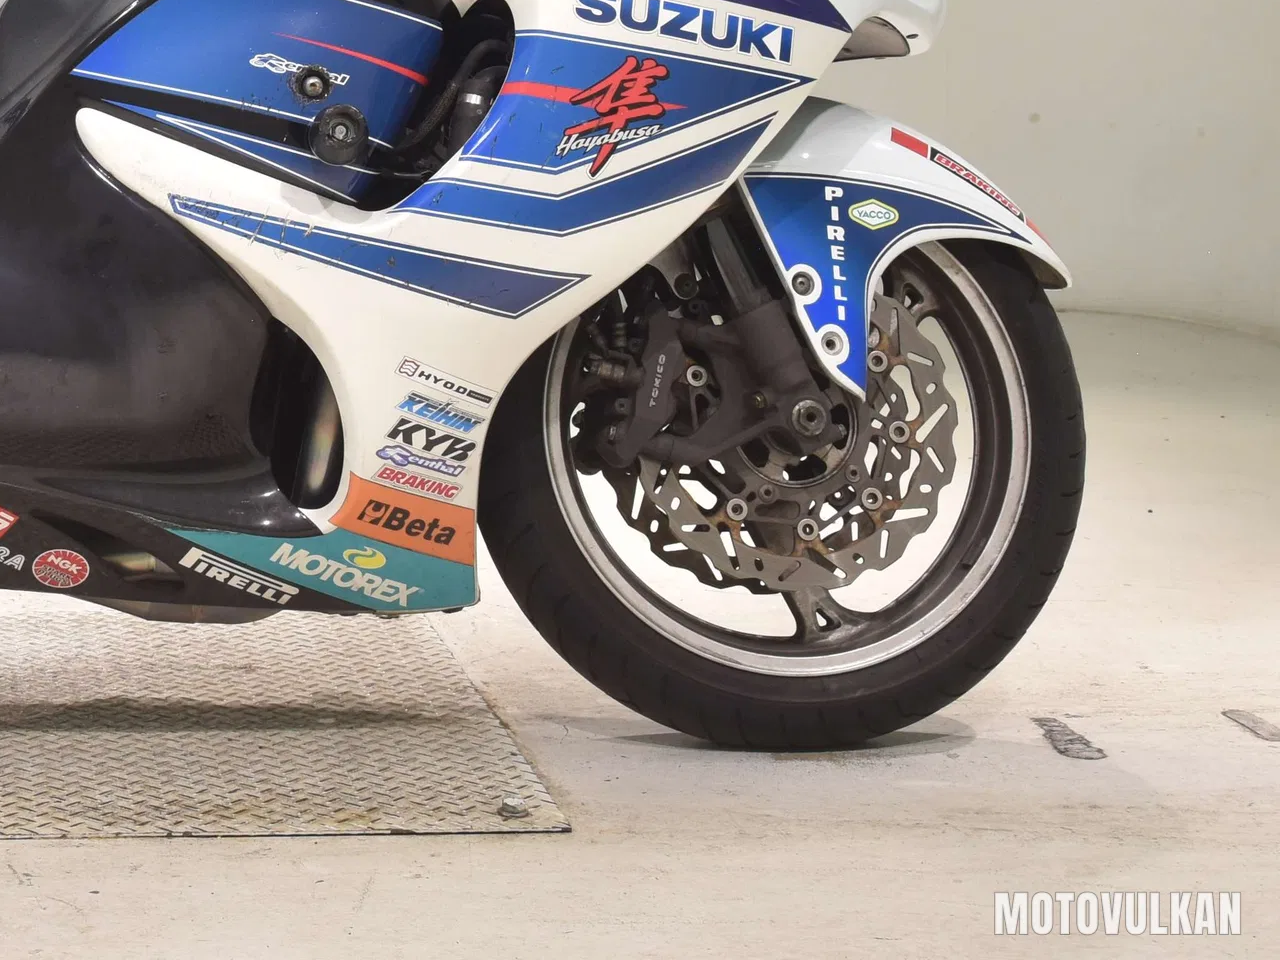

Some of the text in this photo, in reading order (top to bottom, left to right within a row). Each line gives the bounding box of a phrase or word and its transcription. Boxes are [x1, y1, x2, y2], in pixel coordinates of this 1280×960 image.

[564, 55, 669, 177] 隼
[556, 124, 662, 157] Hayabusa
[935, 153, 1020, 215] BRAKING
[857, 209, 891, 220] YACCO
[824, 186, 848, 321] PIRELLI
[418, 371, 469, 397] HYOD
[649, 354, 666, 408] TOKICO
[398, 395, 482, 433] KEIHIN
[376, 445, 466, 477] Renthal
[386, 417, 477, 462] KYB
[377, 467, 460, 499] BRAKING
[383, 503, 456, 546] Beta
[47, 554, 82, 575] NGK
[178, 546, 300, 605] PIRELLI
[269, 542, 414, 607] MOTOREX
